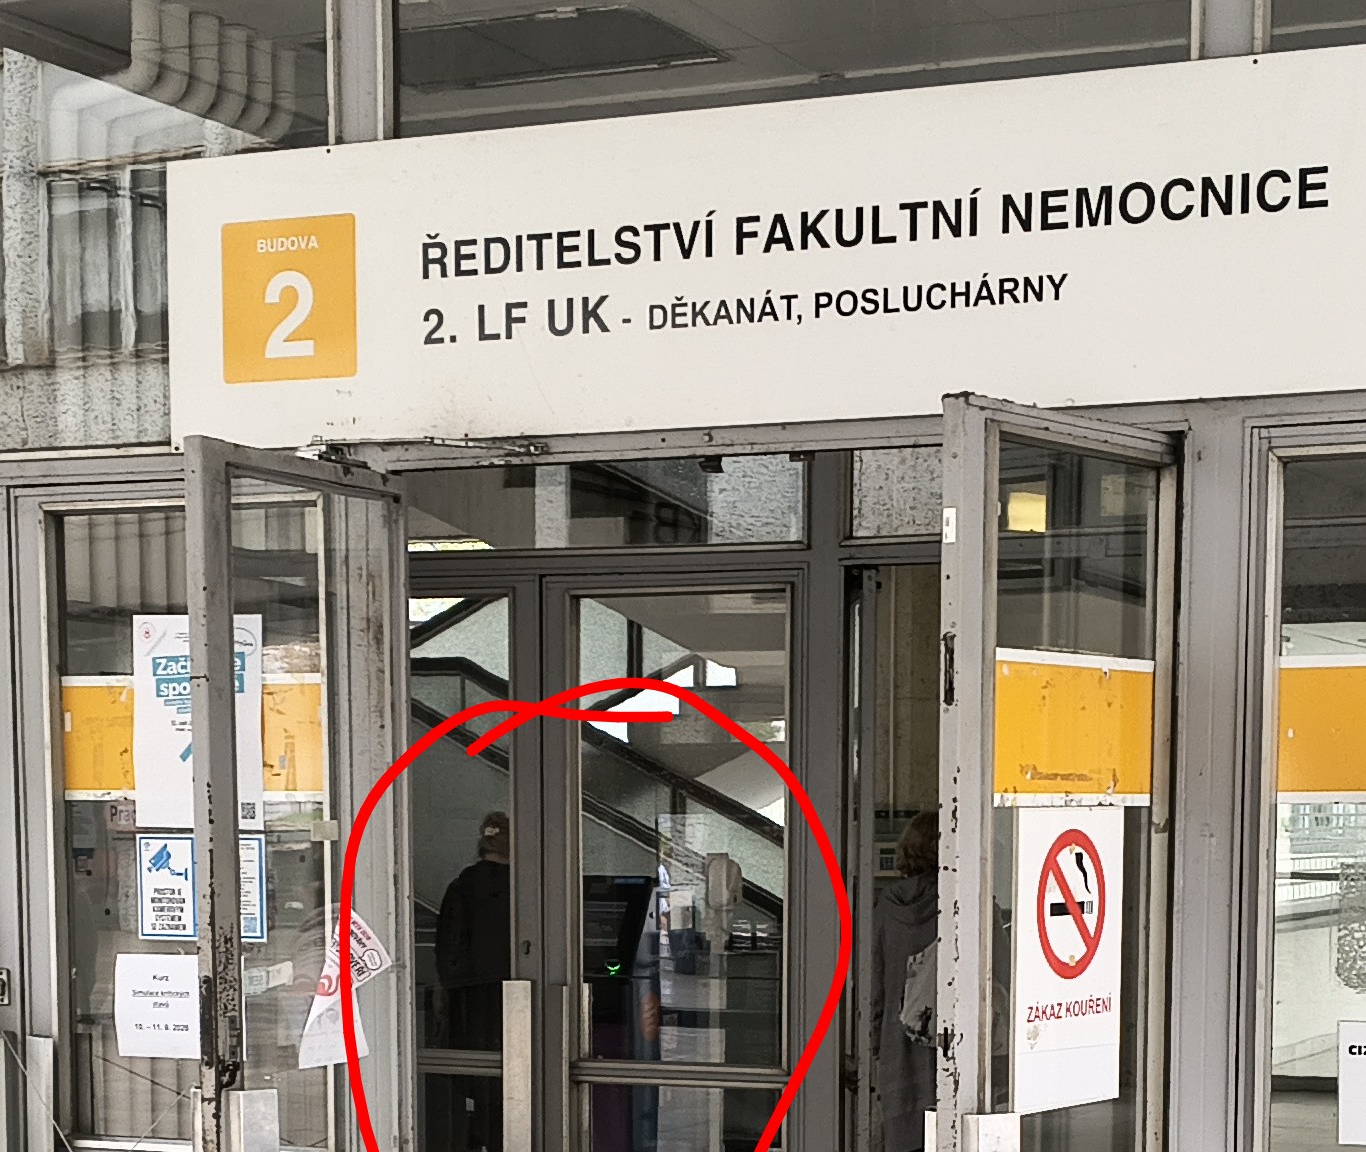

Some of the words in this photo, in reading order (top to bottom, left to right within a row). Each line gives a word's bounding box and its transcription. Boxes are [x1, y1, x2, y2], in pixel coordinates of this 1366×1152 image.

[256, 234, 320, 254] BUDOVA
[421, 209, 717, 280] ŘEDITELSTVÍ
[735, 187, 982, 256] FAKULTNÍ
[1001, 165, 1330, 235] NEMOCNICE
[264, 269, 316, 360] 2
[423, 308, 458, 346] 2.
[477, 301, 528, 342] LF
[547, 294, 611, 338] UK
[648, 289, 804, 331] DĚKANÁT,
[814, 272, 1069, 320] POSLUCHÁRNY
[1026, 1001, 1063, 1023] ZÁKAZ
[1064, 992, 1112, 1018] KOUŘENÍ
